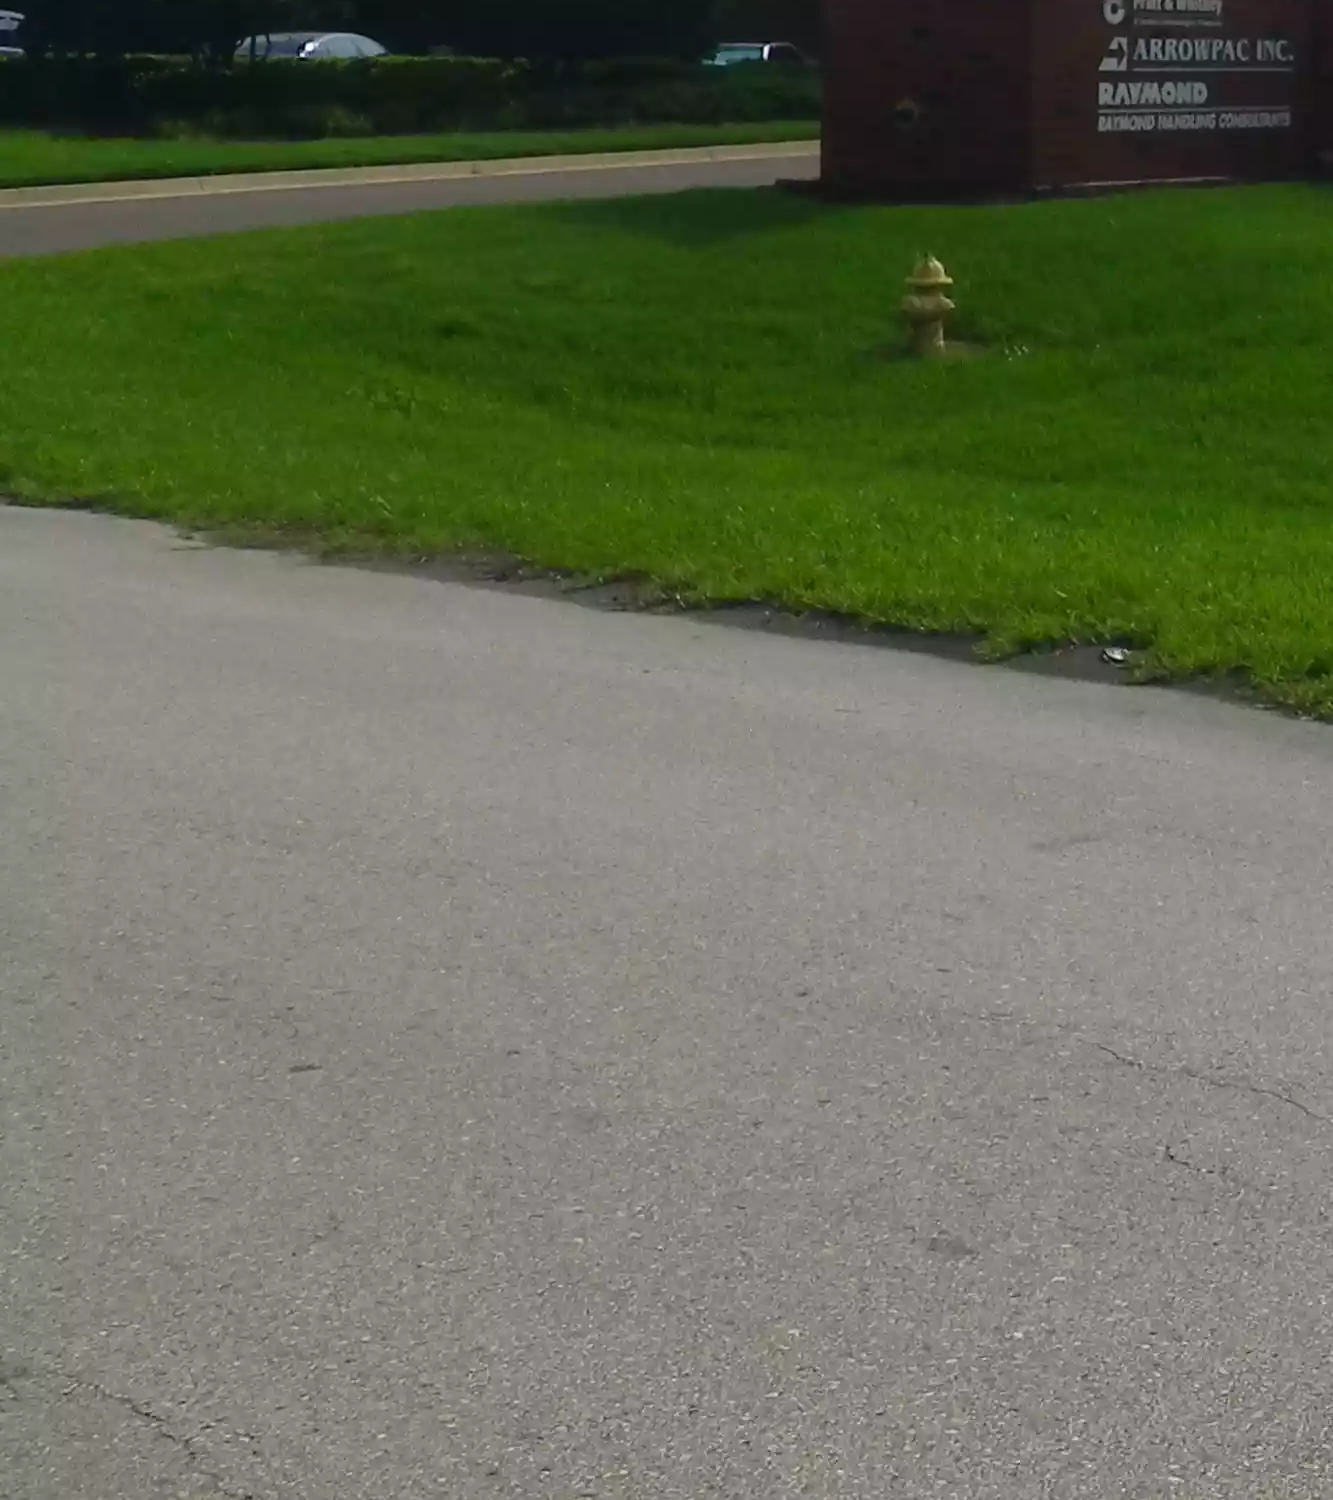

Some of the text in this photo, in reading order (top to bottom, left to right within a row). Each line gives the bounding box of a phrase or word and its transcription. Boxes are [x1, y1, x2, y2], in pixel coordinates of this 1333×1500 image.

[1133, 37, 1294, 62] ARROWPAC INC.
[1098, 82, 1208, 105] RAYMOND
[1098, 113, 1155, 132] RAYMOND
[1158, 113, 1216, 131] HANDLING
